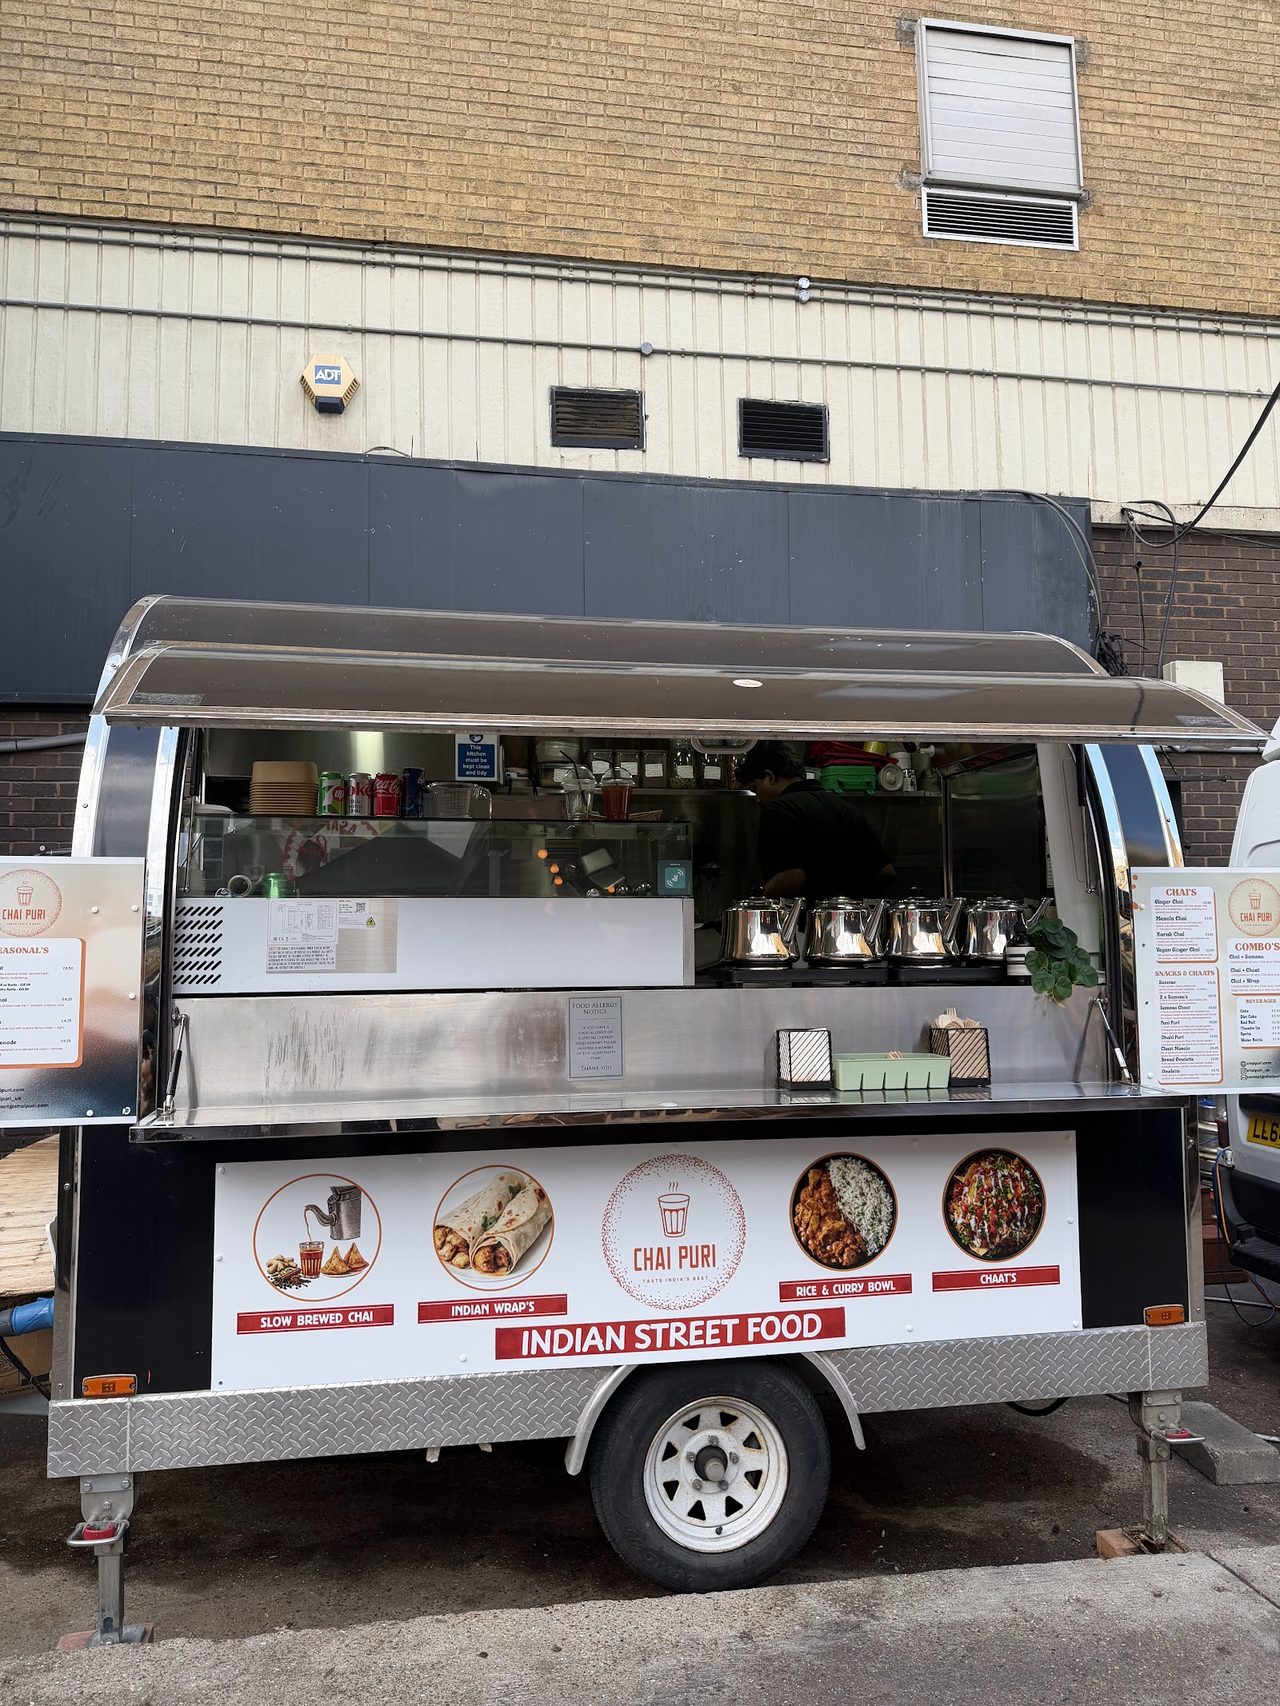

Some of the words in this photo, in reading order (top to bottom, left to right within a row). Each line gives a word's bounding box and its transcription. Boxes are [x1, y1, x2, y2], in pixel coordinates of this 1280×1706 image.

[315, 369, 341, 381] ADT
[476, 769, 487, 777] tidy
[1165, 888, 1197, 897] CHAI'S
[2, 909, 22, 920] CHAI
[25, 909, 46, 920] PURI
[1240, 913, 1255, 922] CHAI
[1257, 912, 1272, 922] PURI
[1235, 942, 1280, 951] COMBO'S
[1252, 1117, 1280, 1142] LL6
[633, 1245, 671, 1272] CHAI
[678, 1244, 716, 1269] PURI
[980, 1272, 1017, 1285] CHAAT'S
[796, 1285, 817, 1297] RICE
[821, 1285, 829, 1296] &
[832, 1282, 864, 1294] CURRY
[868, 1280, 896, 1292] BOWL
[451, 1303, 489, 1317] INDIAN
[494, 1301, 535, 1314] WRAP'S
[260, 1315, 292, 1328] SLOW
[297, 1312, 343, 1326] BREWED
[347, 1310, 373, 1323] CHAI
[521, 1325, 626, 1356] INDIAN
[634, 1318, 740, 1349] STREET
[747, 1313, 822, 1342] FOOD
